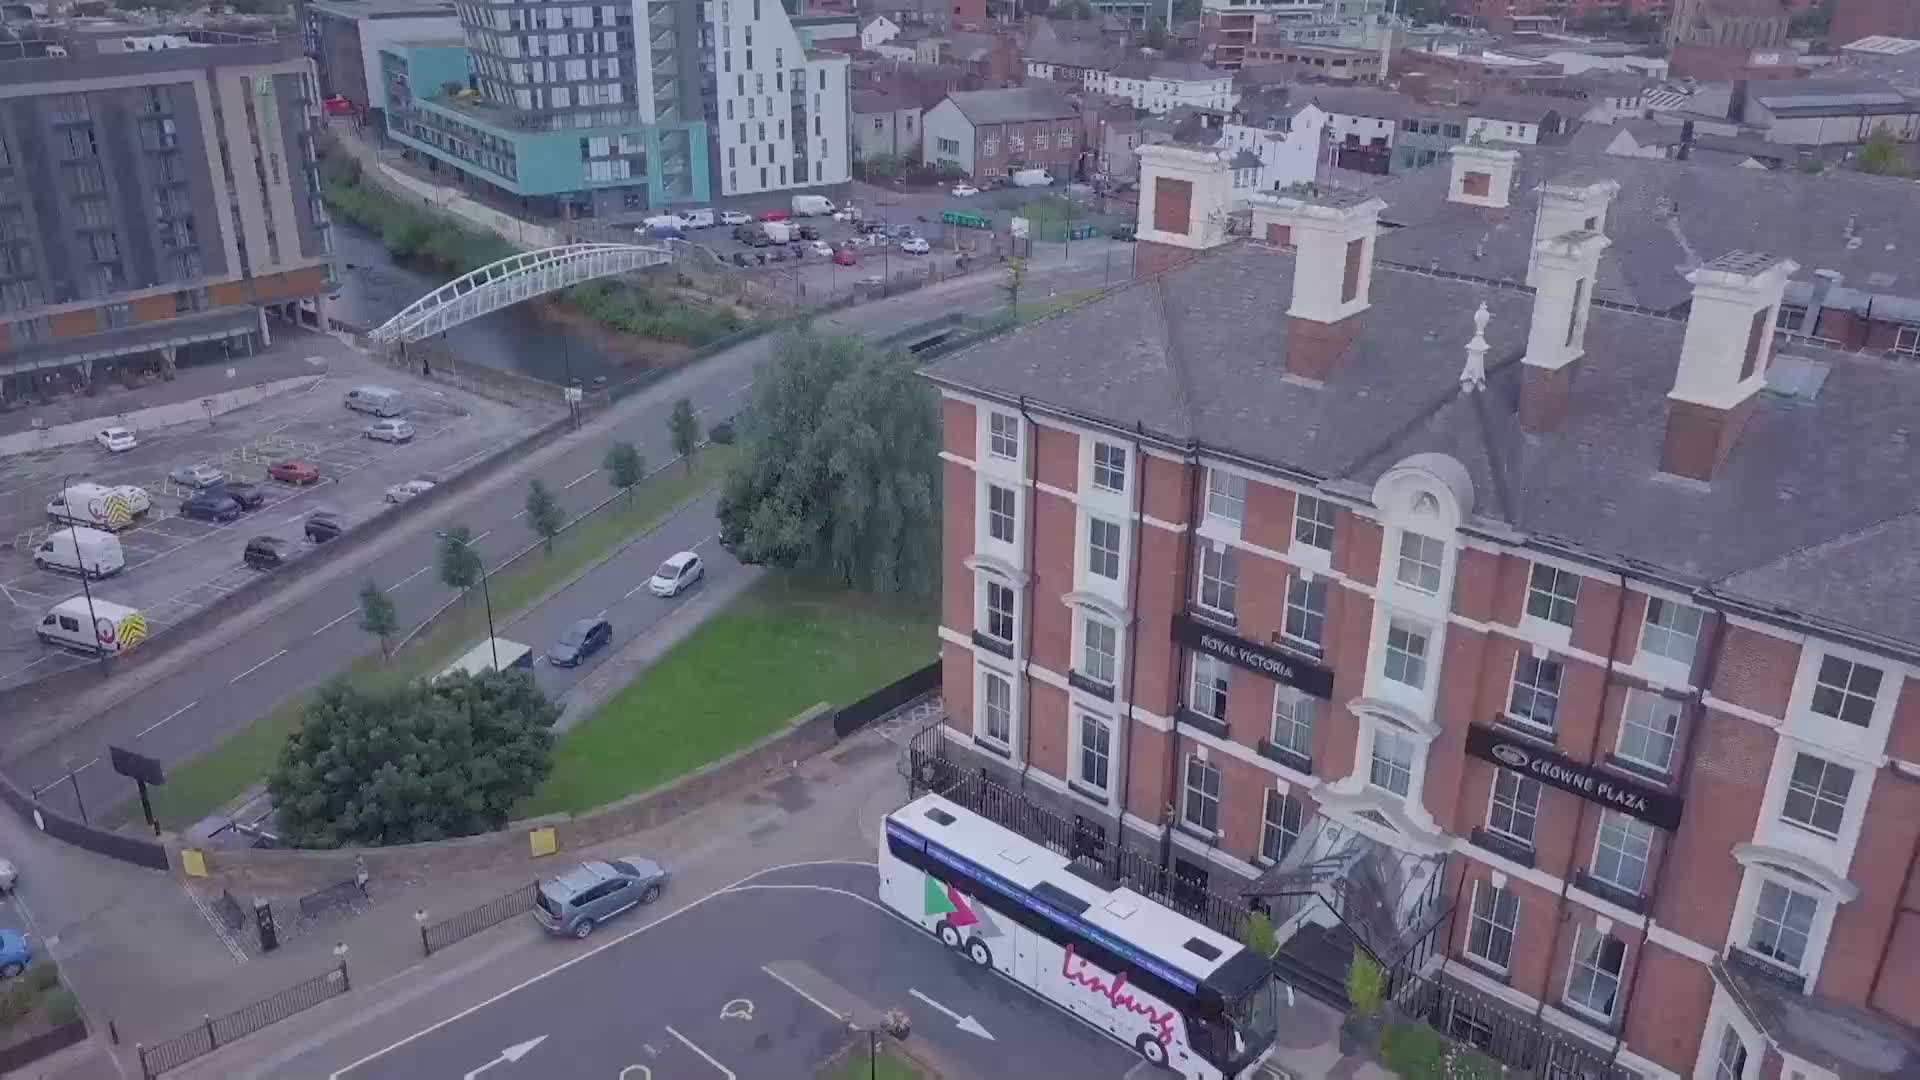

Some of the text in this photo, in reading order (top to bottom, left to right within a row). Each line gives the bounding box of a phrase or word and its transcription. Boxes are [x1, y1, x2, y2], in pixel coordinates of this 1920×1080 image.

[1200, 635, 1294, 678] ROYAL VICTORIA
[1531, 759, 1647, 812] CROWNE PLAZA
